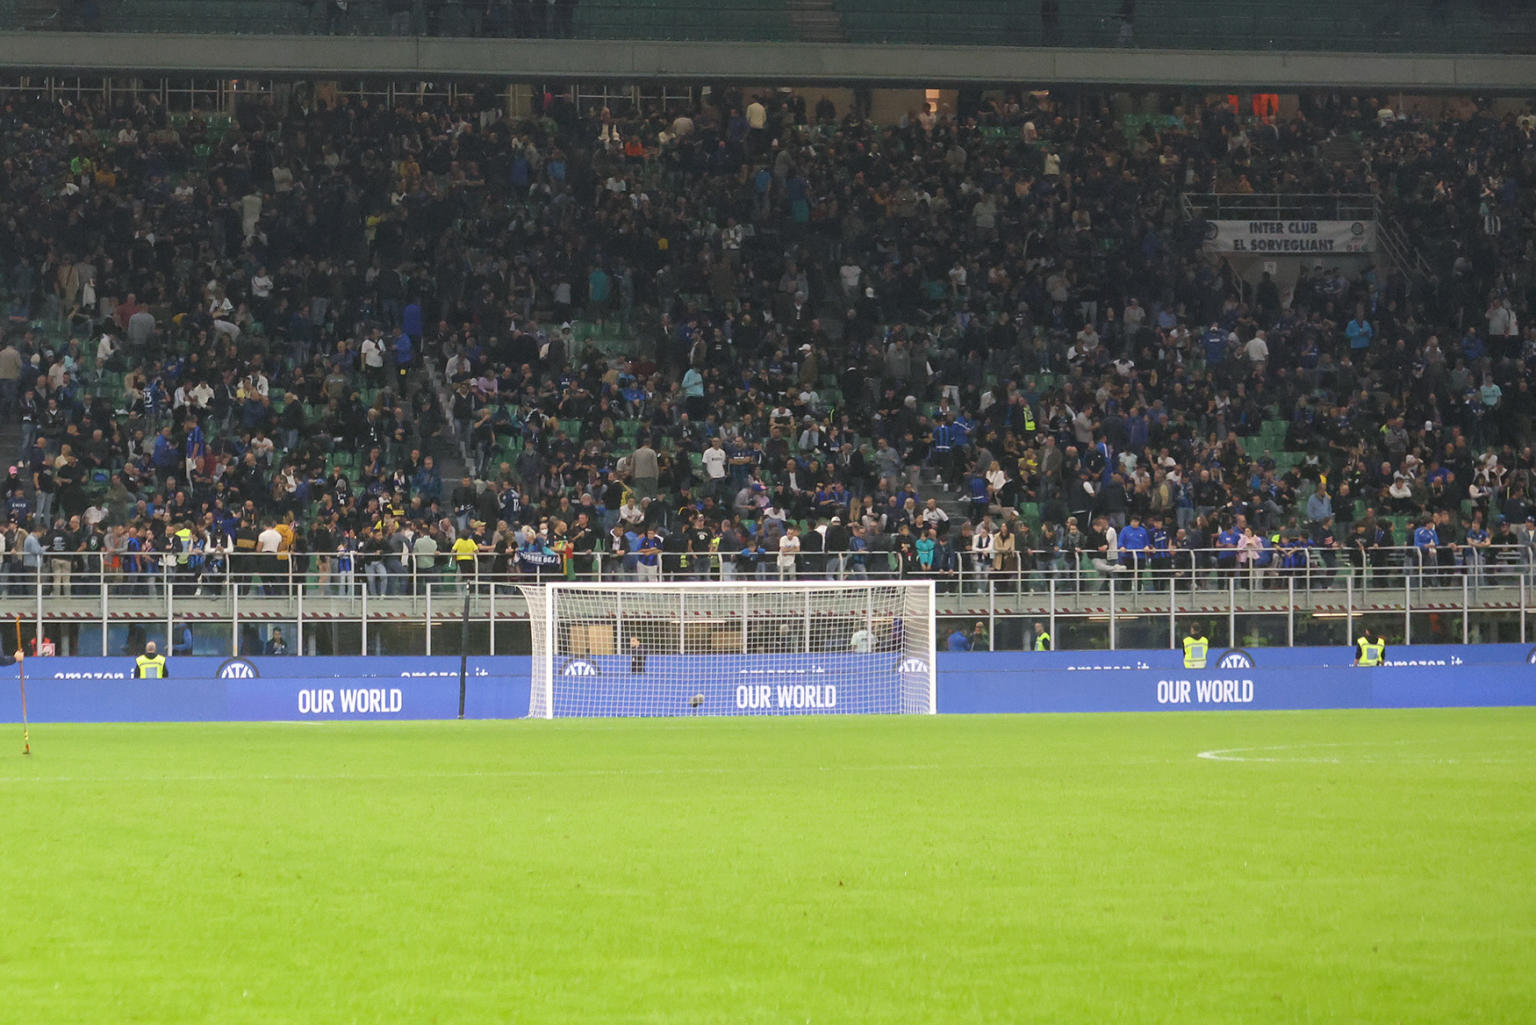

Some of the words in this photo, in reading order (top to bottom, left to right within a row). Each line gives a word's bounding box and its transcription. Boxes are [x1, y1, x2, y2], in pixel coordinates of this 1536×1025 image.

[1249, 222, 1284, 234] INTER
[1288, 222, 1318, 234] CLUB
[1233, 239, 1247, 251] EL
[297, 688, 335, 714] OUR
[339, 688, 403, 714] WORLD
[735, 684, 772, 709] OUR
[776, 684, 837, 709] WORLD
[1156, 679, 1191, 704] OUR
[1195, 679, 1254, 704] WORLD
